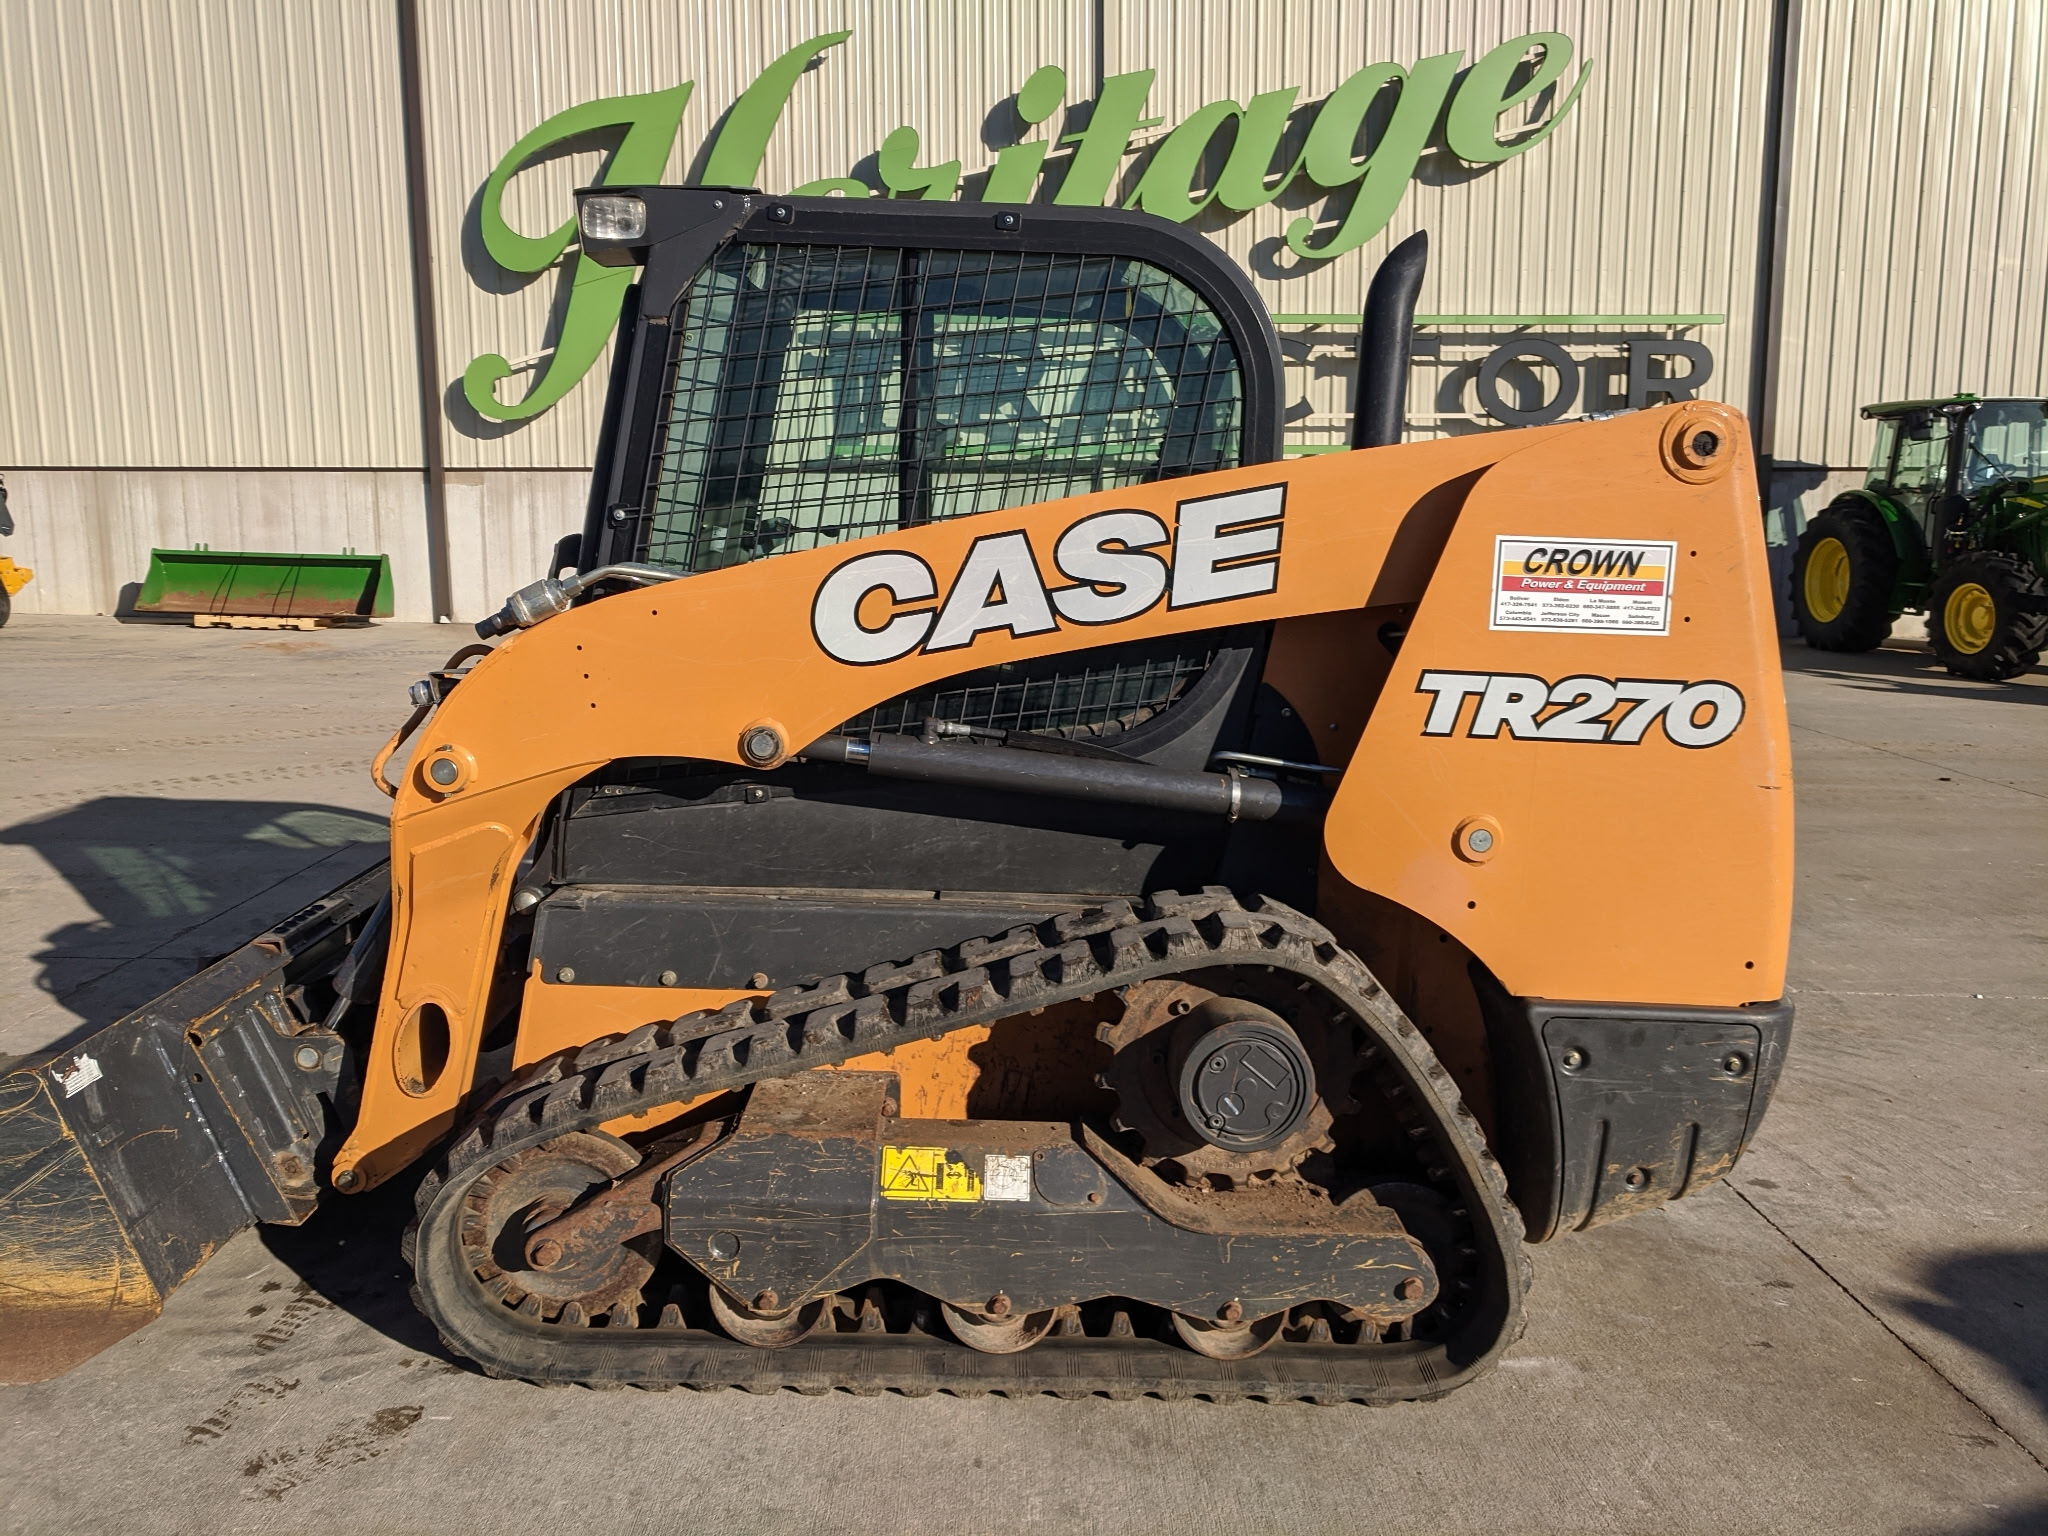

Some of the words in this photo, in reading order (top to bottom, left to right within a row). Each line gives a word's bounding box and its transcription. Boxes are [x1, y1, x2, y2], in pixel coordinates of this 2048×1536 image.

[464, 30, 1593, 421] Hritage
[810, 481, 1289, 667] CASE
[1520, 578, 1564, 589] Power
[1564, 580, 1574, 589] &
[1577, 580, 1647, 592] Equipment
[1523, 548, 1645, 577] CROWN
[1415, 669, 1746, 750] TR270
